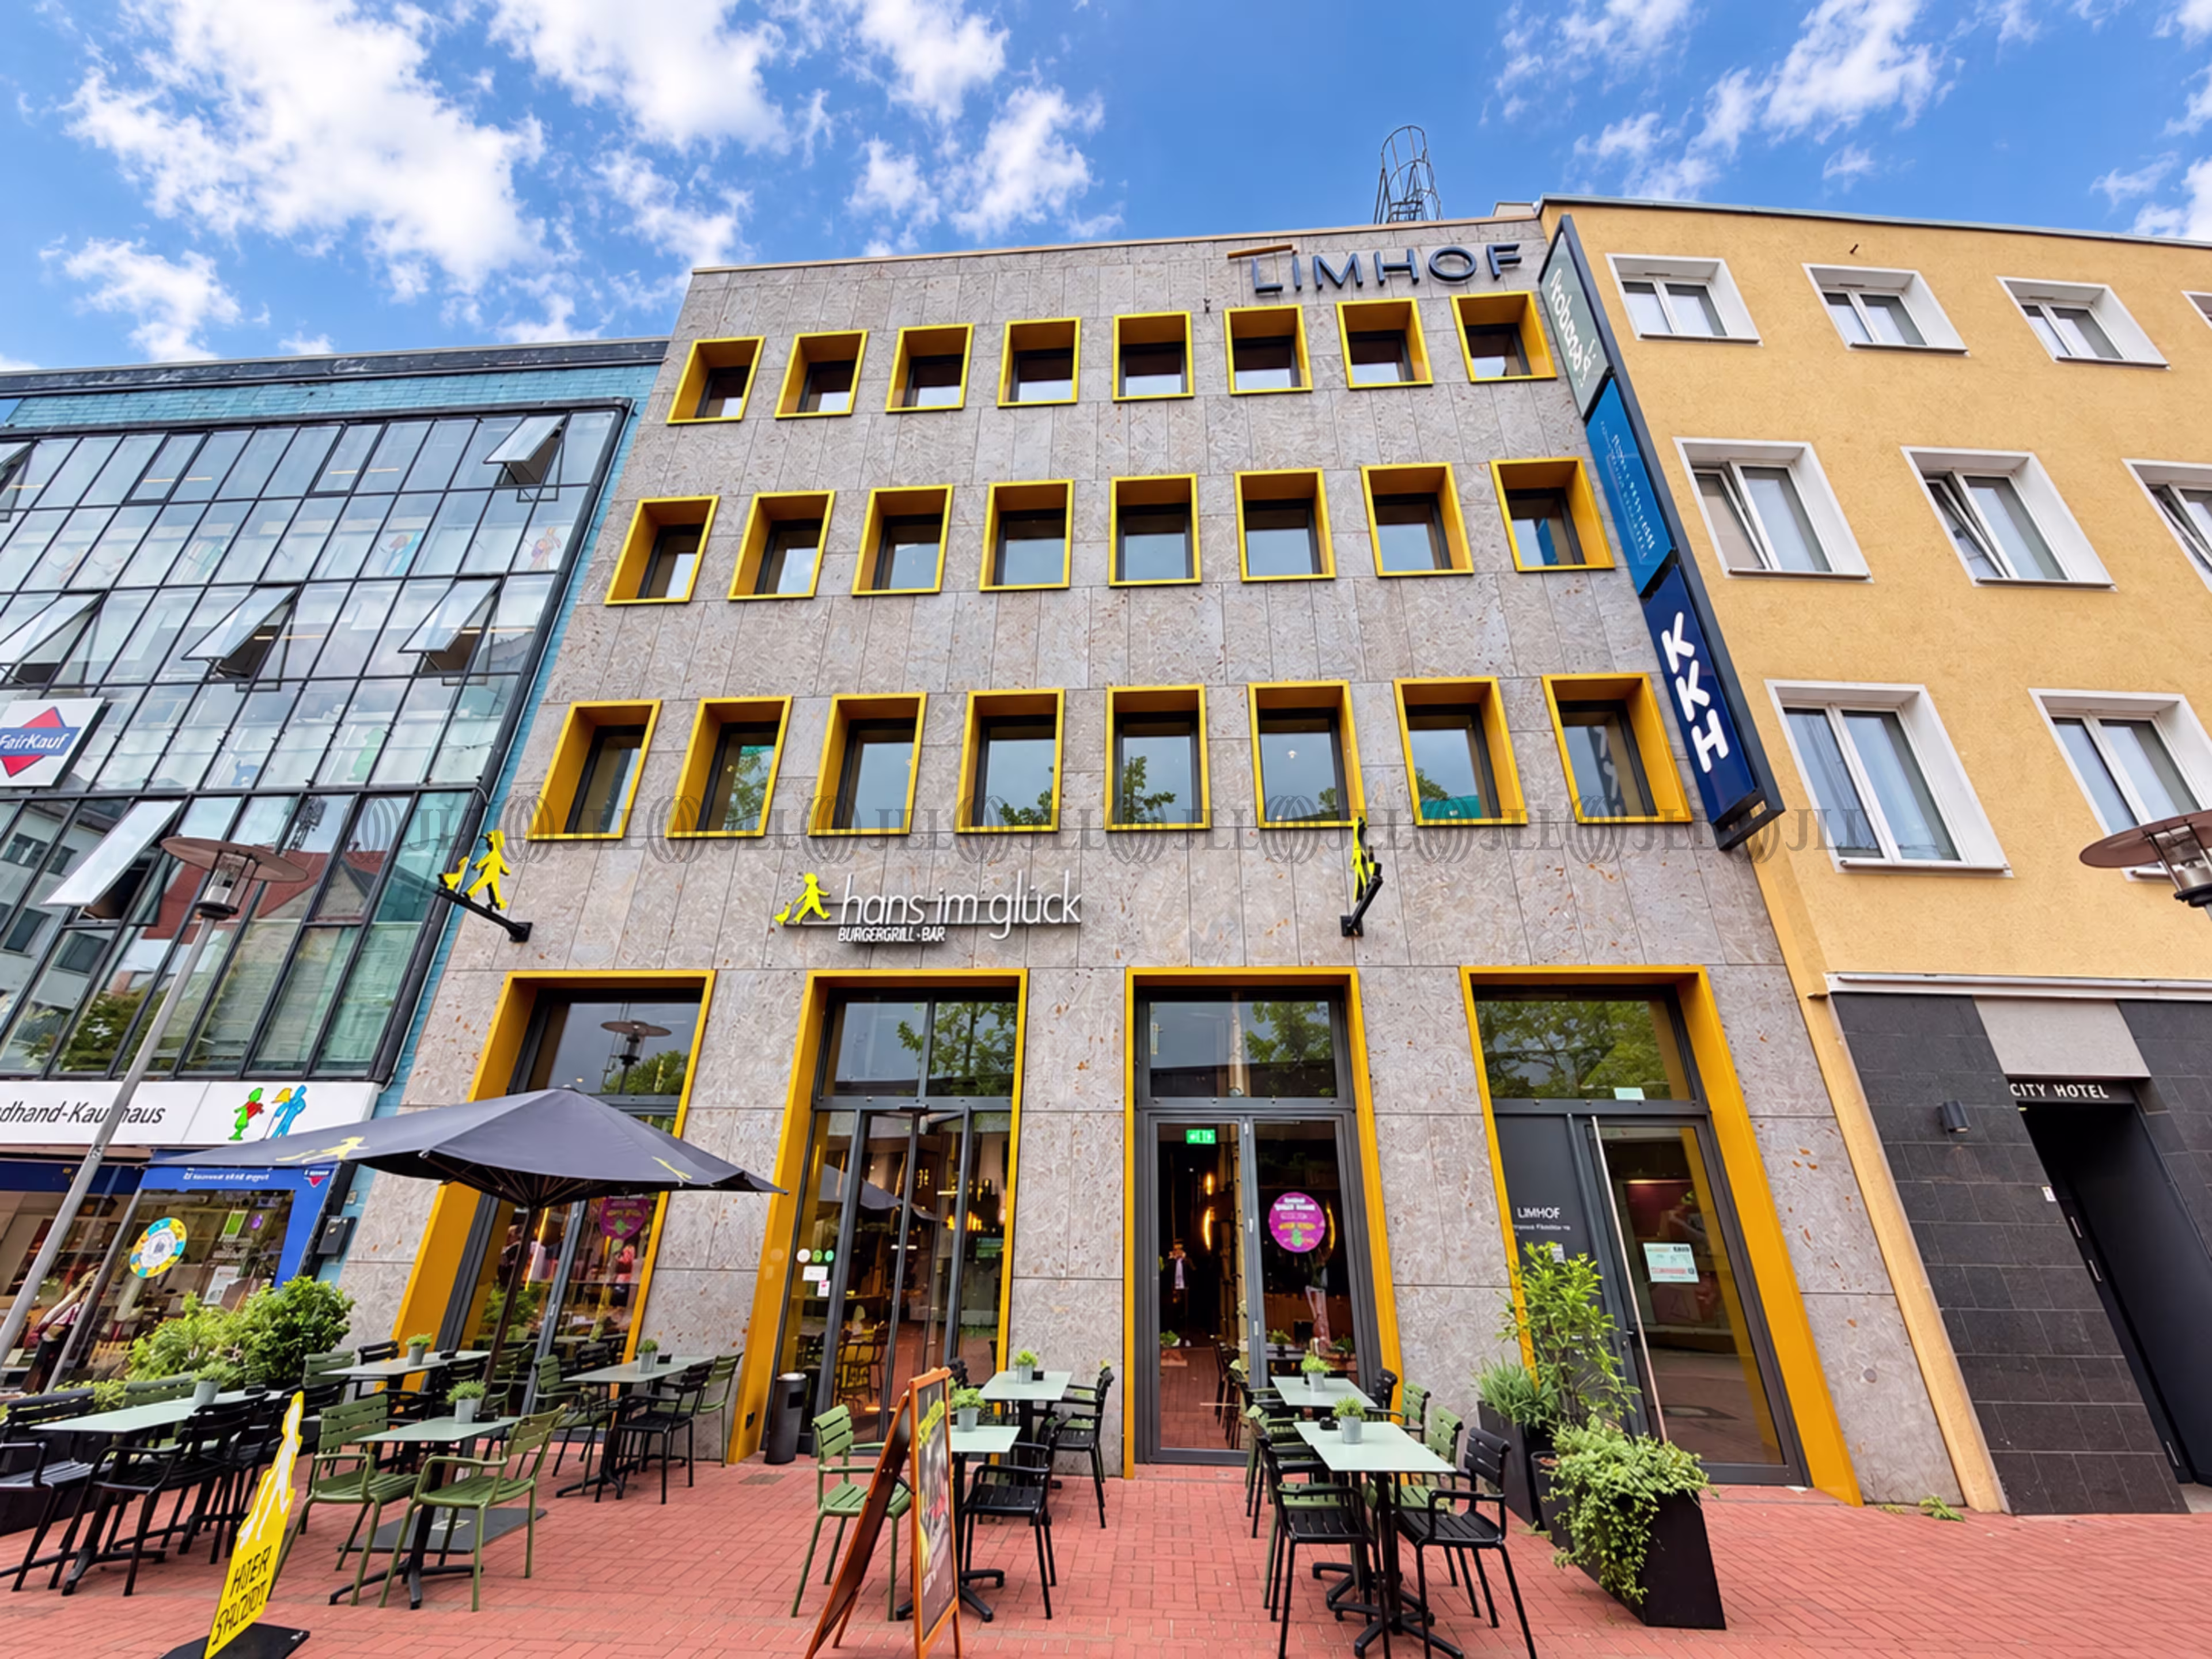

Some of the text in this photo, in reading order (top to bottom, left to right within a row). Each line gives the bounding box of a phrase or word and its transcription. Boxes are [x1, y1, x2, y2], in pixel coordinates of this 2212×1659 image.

[1251, 243, 1522, 293] LIMHOF
[1661, 612, 1729, 772] KKH
[840, 869, 1081, 940] hans im glück
[838, 927, 945, 942] BURGERGRILL BAR
[2010, 1083, 2109, 1099] CITY HOTEL
[1517, 1207, 1560, 1219] LIMHOF
